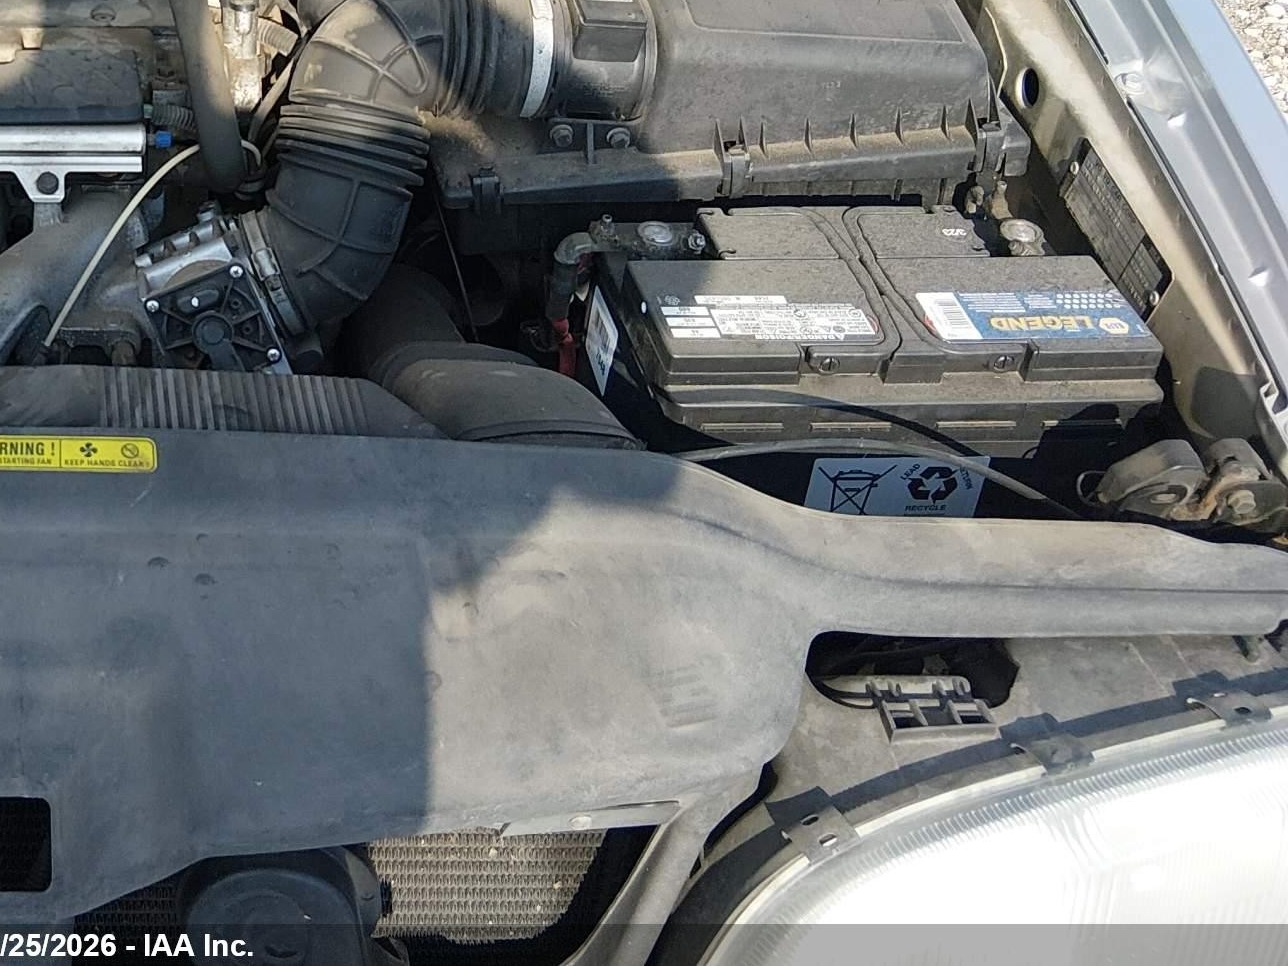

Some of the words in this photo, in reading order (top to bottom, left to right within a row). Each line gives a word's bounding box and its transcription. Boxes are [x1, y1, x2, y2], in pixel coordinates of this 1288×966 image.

[988, 315, 1094, 332] LEGEND
[37, 457, 52, 465] FAN
[64, 459, 85, 467] KEEP
[87, 459, 116, 467] HANDS
[900, 462, 921, 481] LEAD
